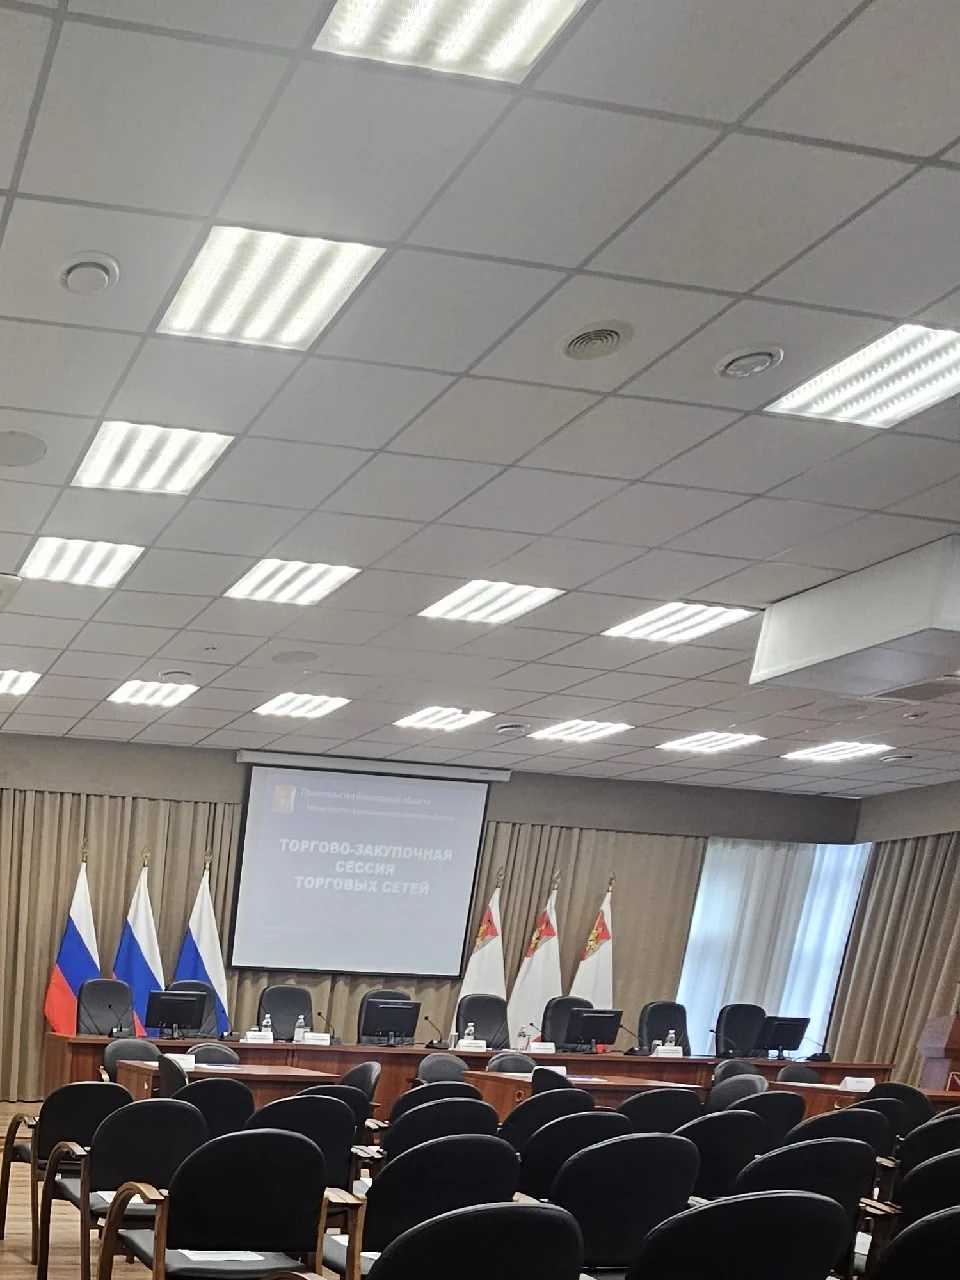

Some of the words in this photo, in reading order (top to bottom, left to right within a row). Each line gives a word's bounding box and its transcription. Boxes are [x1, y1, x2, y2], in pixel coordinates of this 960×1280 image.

[279, 838, 453, 862] ТОРГОВО-ЗАКУПОЧНАЯ
[335, 860, 395, 876] СЕССИЯ
[294, 876, 378, 894] ТОРГОВЫХ
[382, 880, 430, 896] СЕТЕЙ
